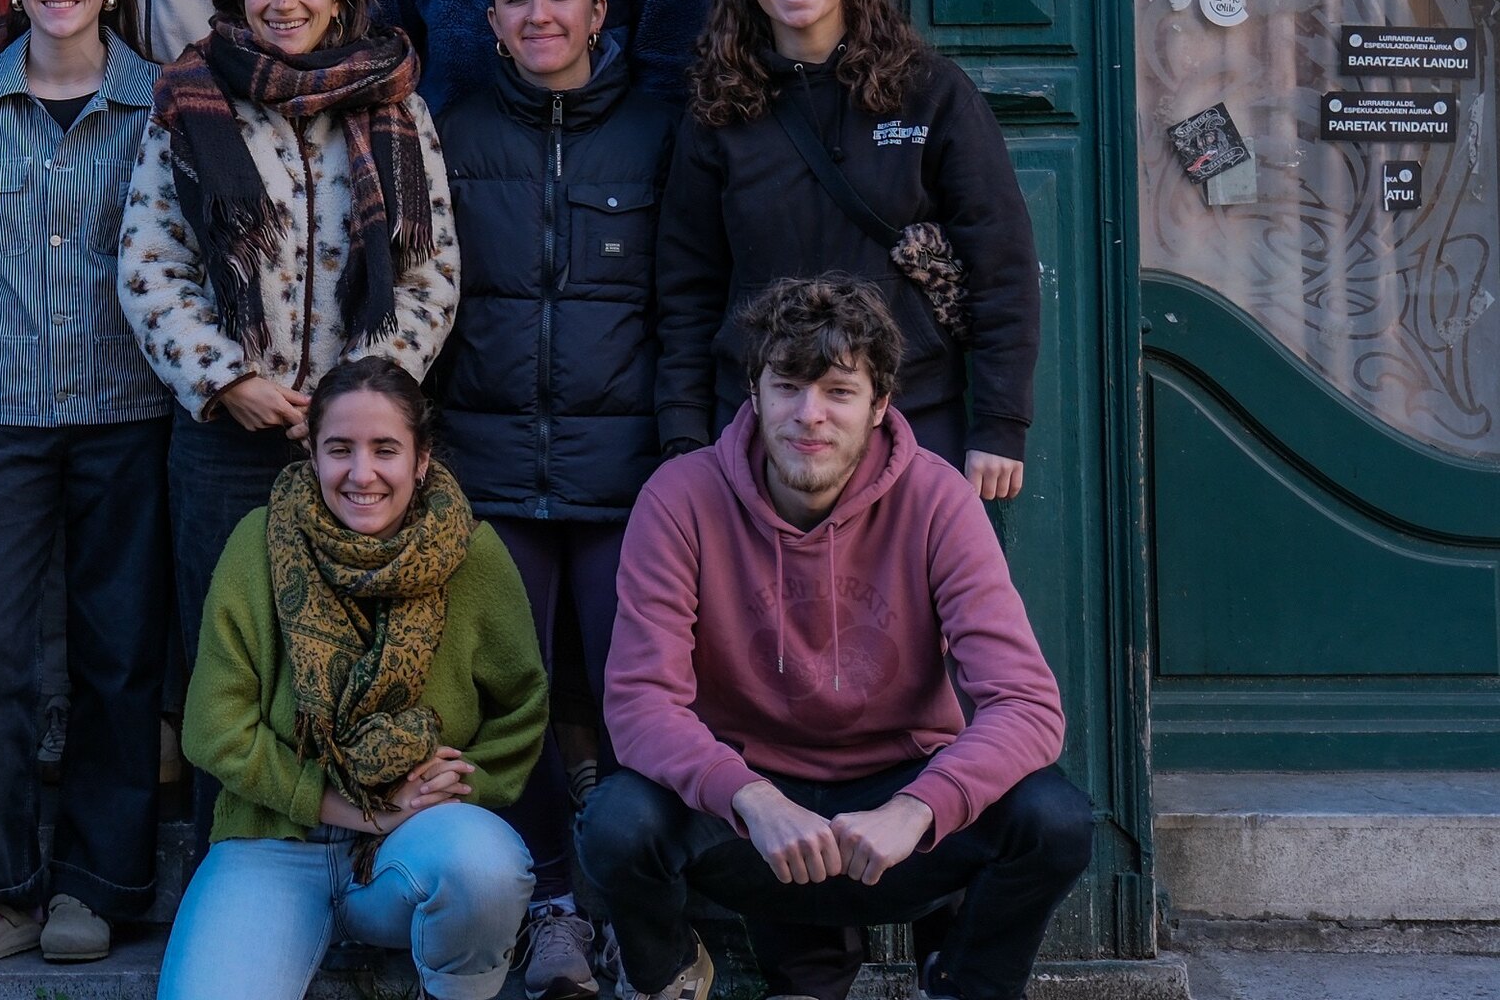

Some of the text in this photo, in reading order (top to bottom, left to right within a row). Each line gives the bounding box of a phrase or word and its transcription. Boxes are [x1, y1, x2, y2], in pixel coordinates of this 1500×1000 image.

[1378, 35, 1415, 43] LURRAREN
[1363, 42, 1453, 51] ESPEKULAZIOAREN AURKA
[1348, 56, 1468, 69] BARATZEAK LANDU!
[1328, 120, 1448, 133] PARETAK TINDATU!
[1385, 190, 1414, 200] ATU!
